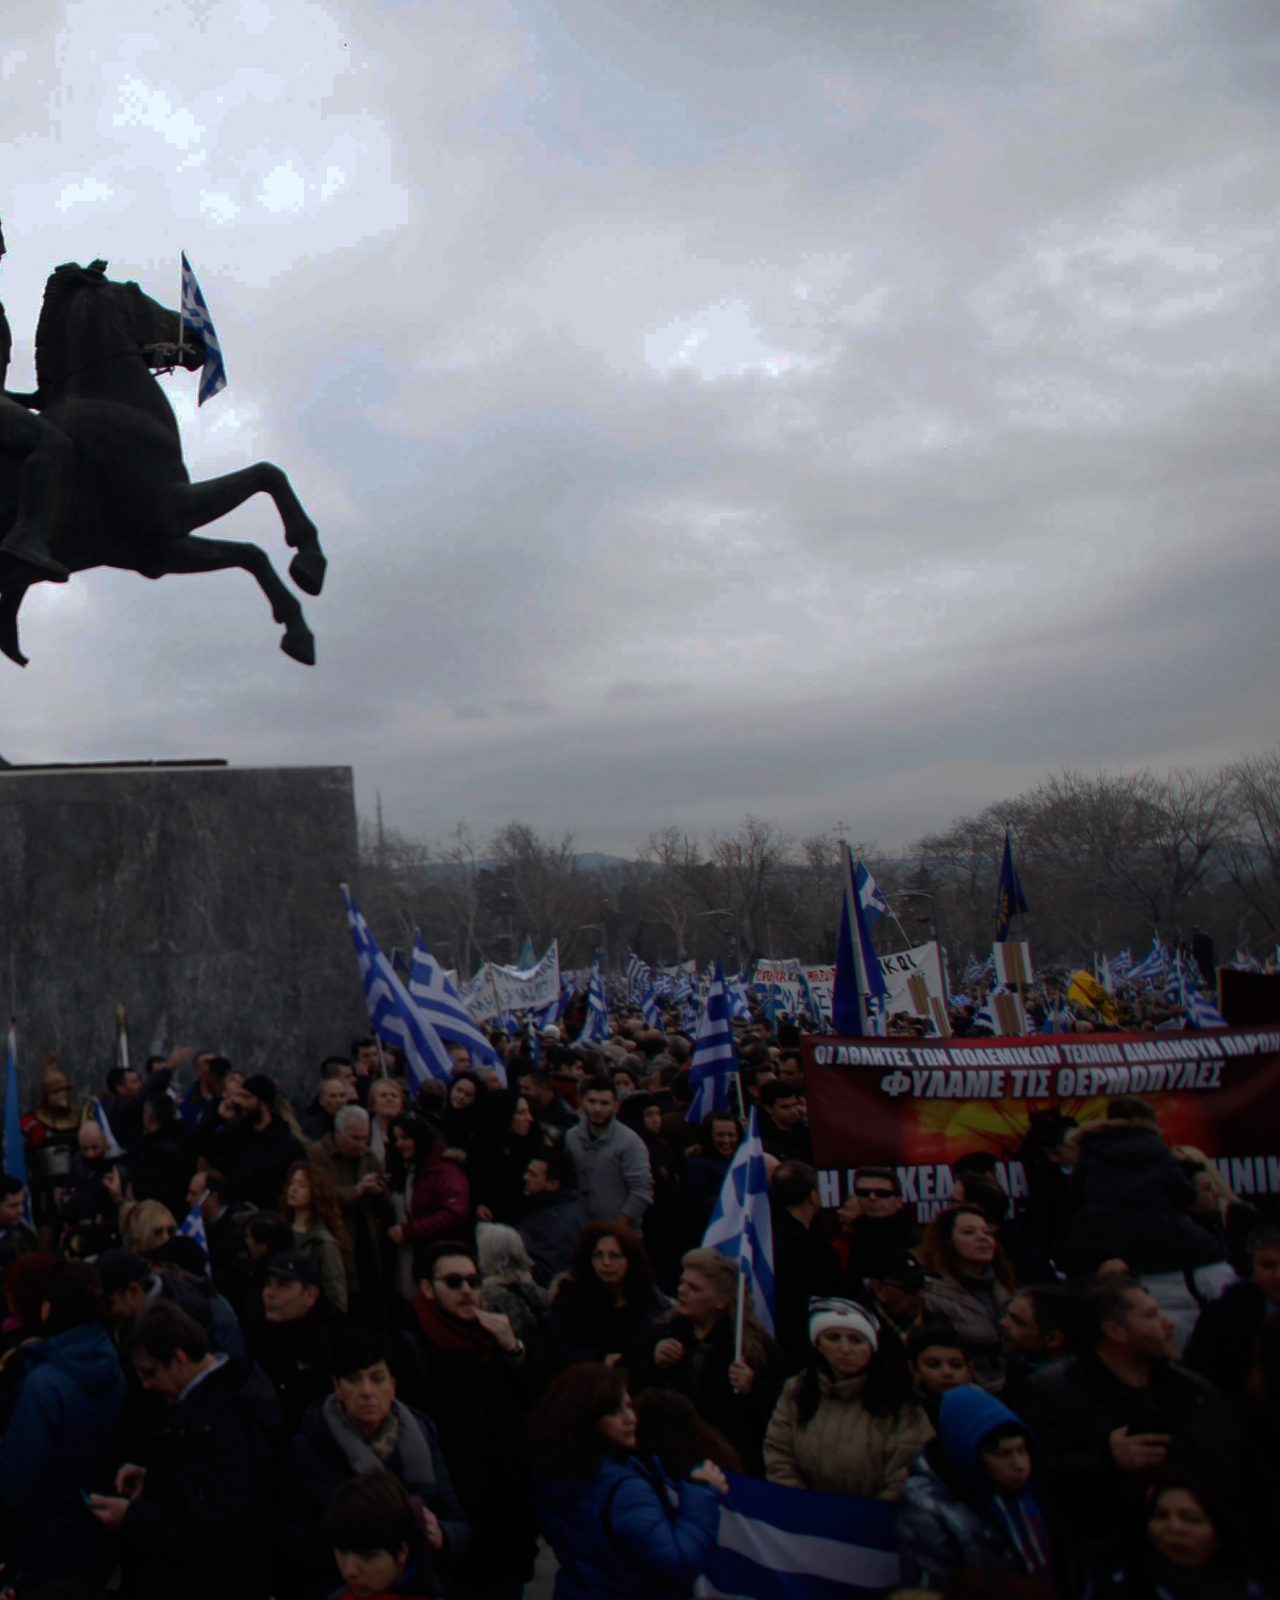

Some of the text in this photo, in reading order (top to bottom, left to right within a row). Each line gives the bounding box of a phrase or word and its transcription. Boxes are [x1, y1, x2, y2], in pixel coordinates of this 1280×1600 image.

[814, 1045, 833, 1065] ΟΙ
[835, 1045, 913, 1067] ΑΘΛΗΤΕΣ
[910, 1047, 951, 1067] ΤΩΝ
[949, 1045, 1061, 1066] ΠΟΛΕΜΙΚΩΝ
[1060, 1043, 1124, 1064] ΤΕΧΝΩΝ
[880, 1060, 1225, 1098] ΦΥΛΑΜΕ ΤΙΣ ΘΕΡΜΟΠΥΛΕΣ
